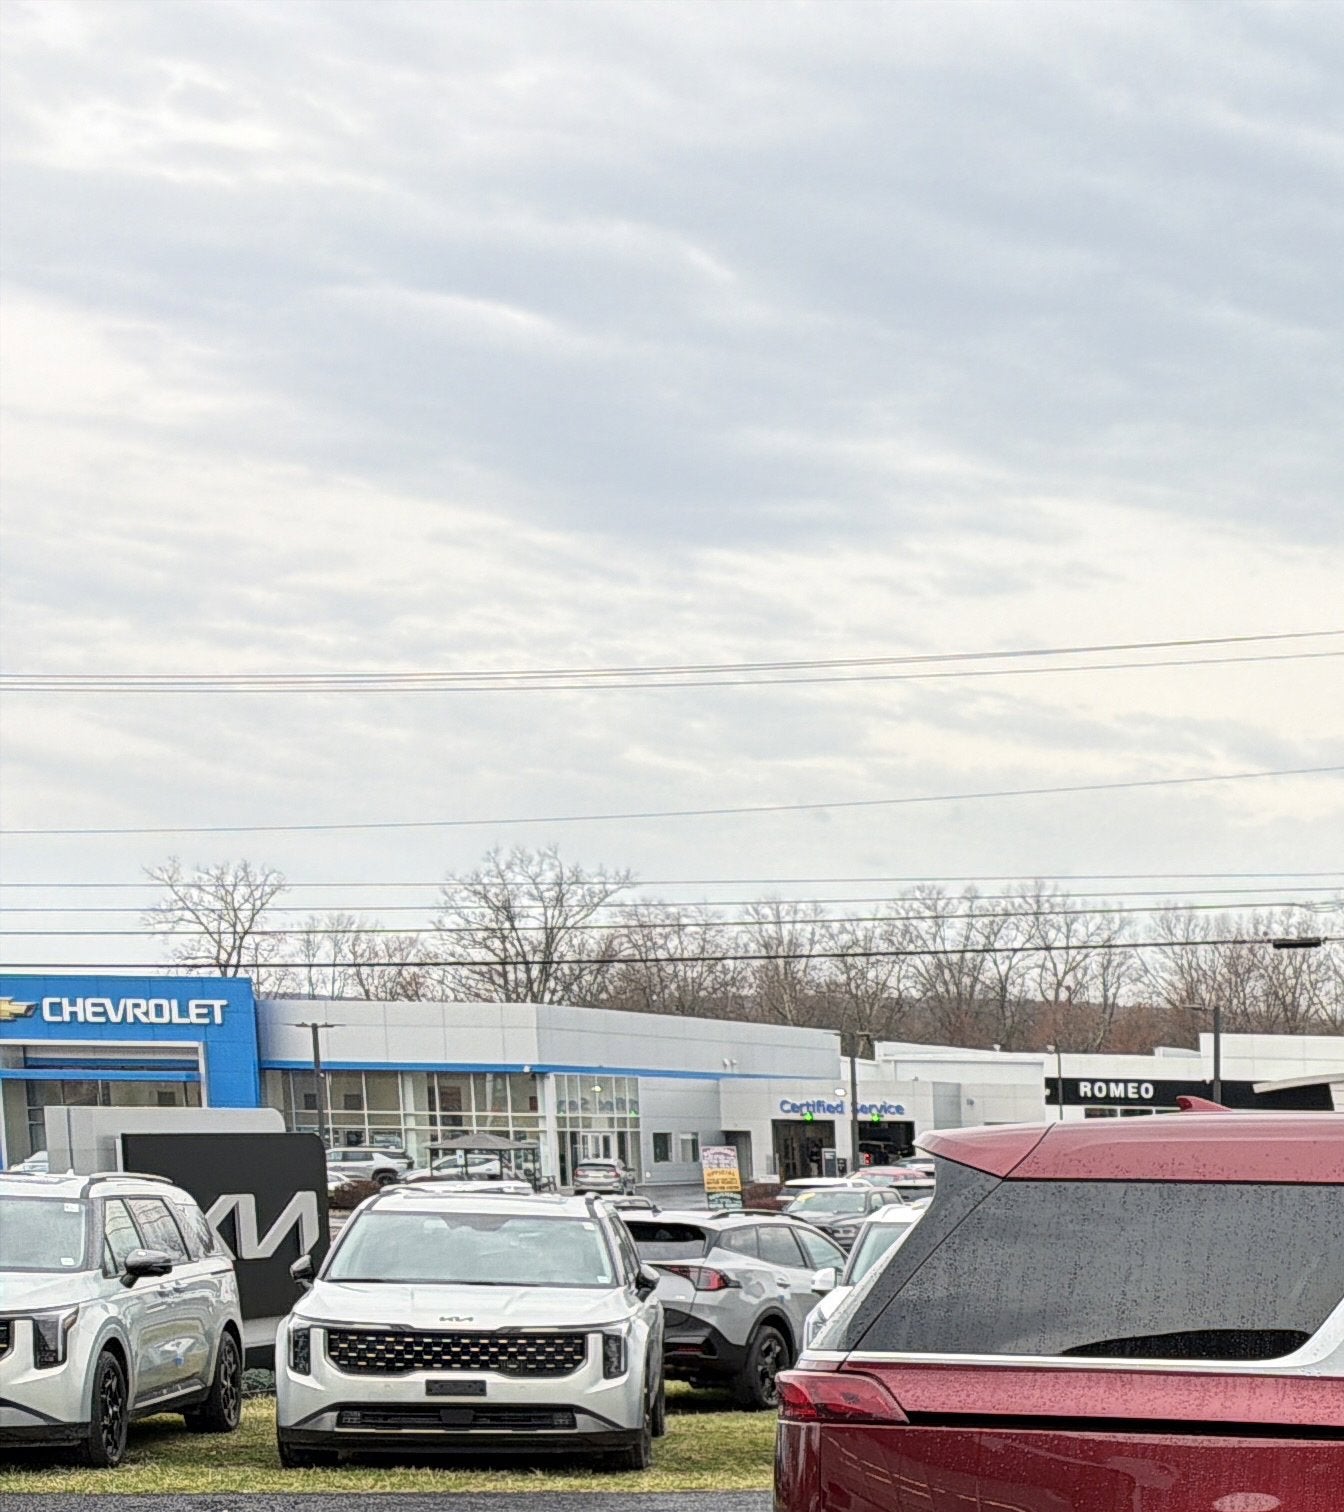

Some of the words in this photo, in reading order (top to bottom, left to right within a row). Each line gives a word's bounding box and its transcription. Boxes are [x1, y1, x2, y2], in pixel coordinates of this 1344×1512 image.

[42, 997, 229, 1024] CHEVROLET
[1079, 1081, 1154, 1099] ROMEO
[780, 1099, 845, 1115] Certified
[852, 1101, 905, 1115] ervice
